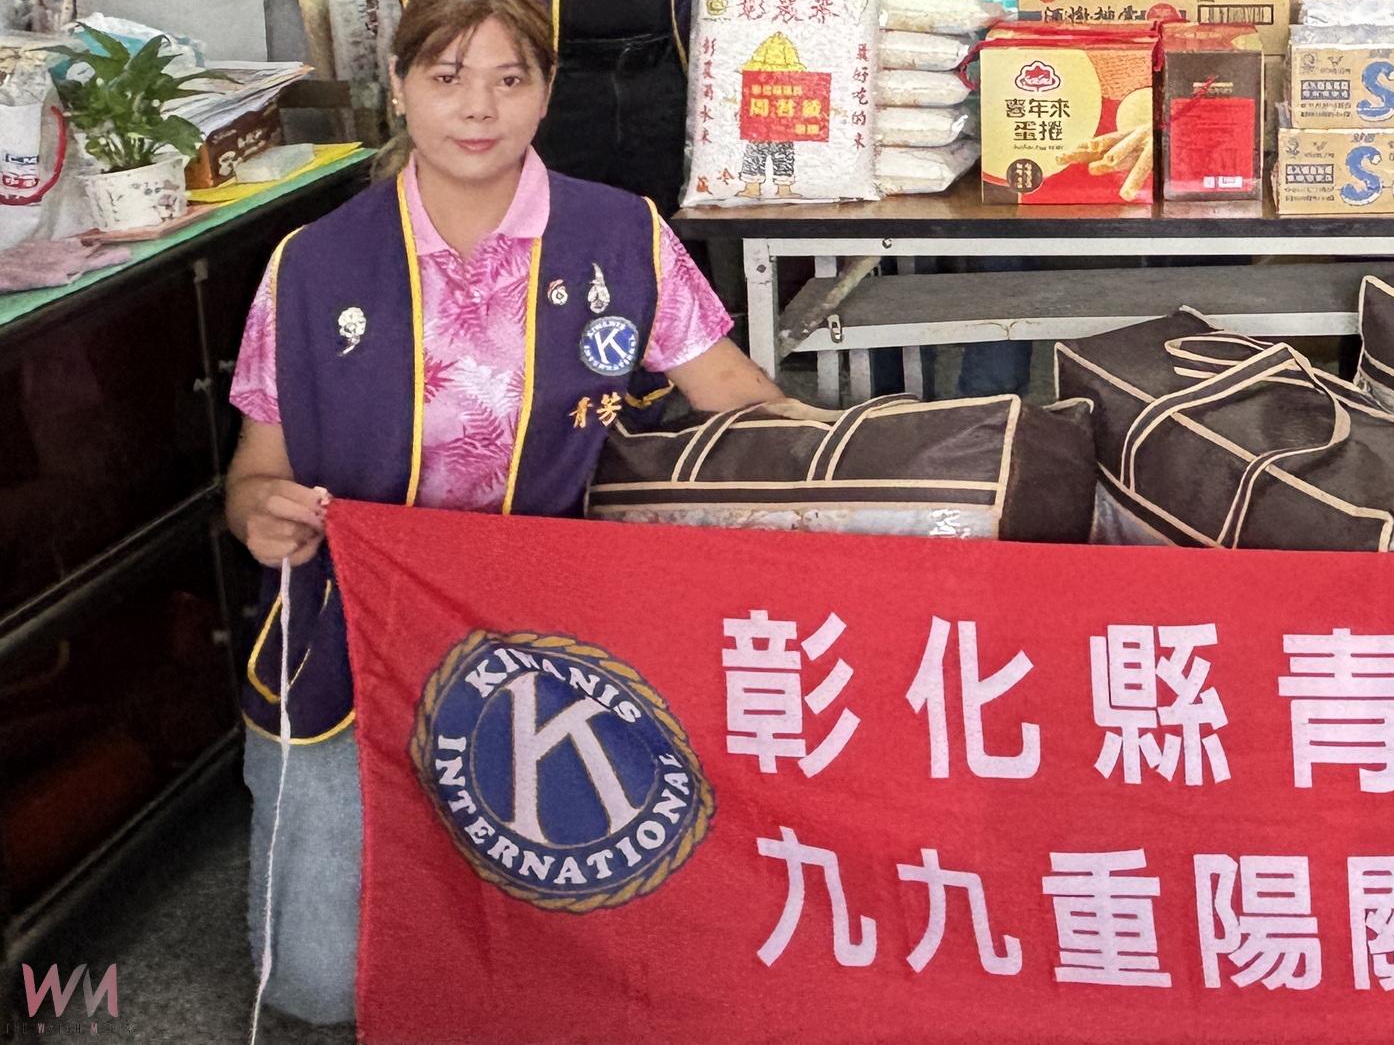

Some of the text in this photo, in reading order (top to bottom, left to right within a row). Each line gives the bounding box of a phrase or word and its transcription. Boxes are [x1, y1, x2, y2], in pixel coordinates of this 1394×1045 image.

[1004, 97, 1071, 119] 喜年來
[1013, 120, 1063, 141] 蛋捲
[594, 328, 631, 365] K
[465, 648, 642, 723] KIWANIS
[499, 670, 642, 845] K
[435, 734, 690, 885] INTERNATIONAL
